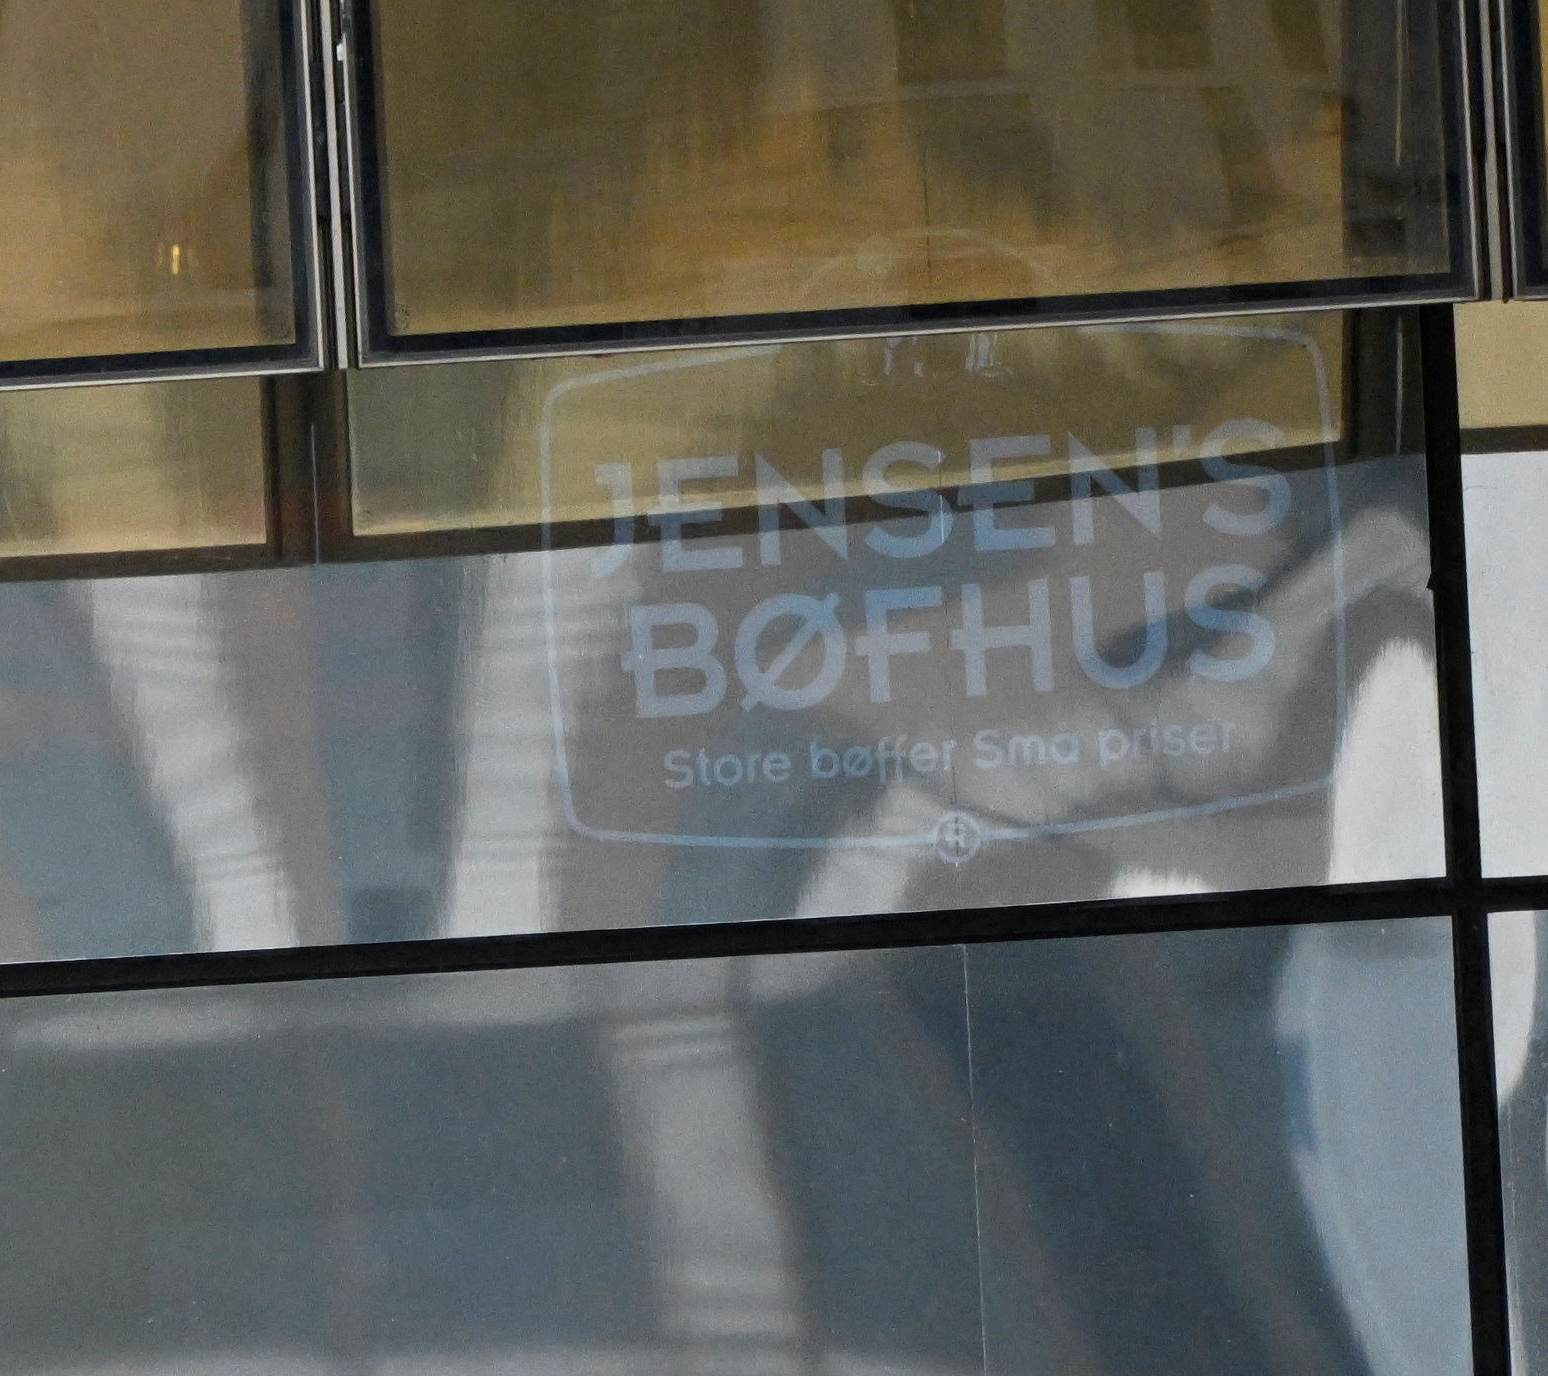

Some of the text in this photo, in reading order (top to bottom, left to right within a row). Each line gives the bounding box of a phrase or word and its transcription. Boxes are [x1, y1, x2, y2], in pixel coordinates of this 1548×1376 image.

[590, 418, 1293, 578] JENSEN'S
[619, 563, 1276, 720] BØFHUS
[664, 748, 792, 790] Store
[809, 736, 956, 783] bøffer
[1097, 718, 1233, 769] priser
